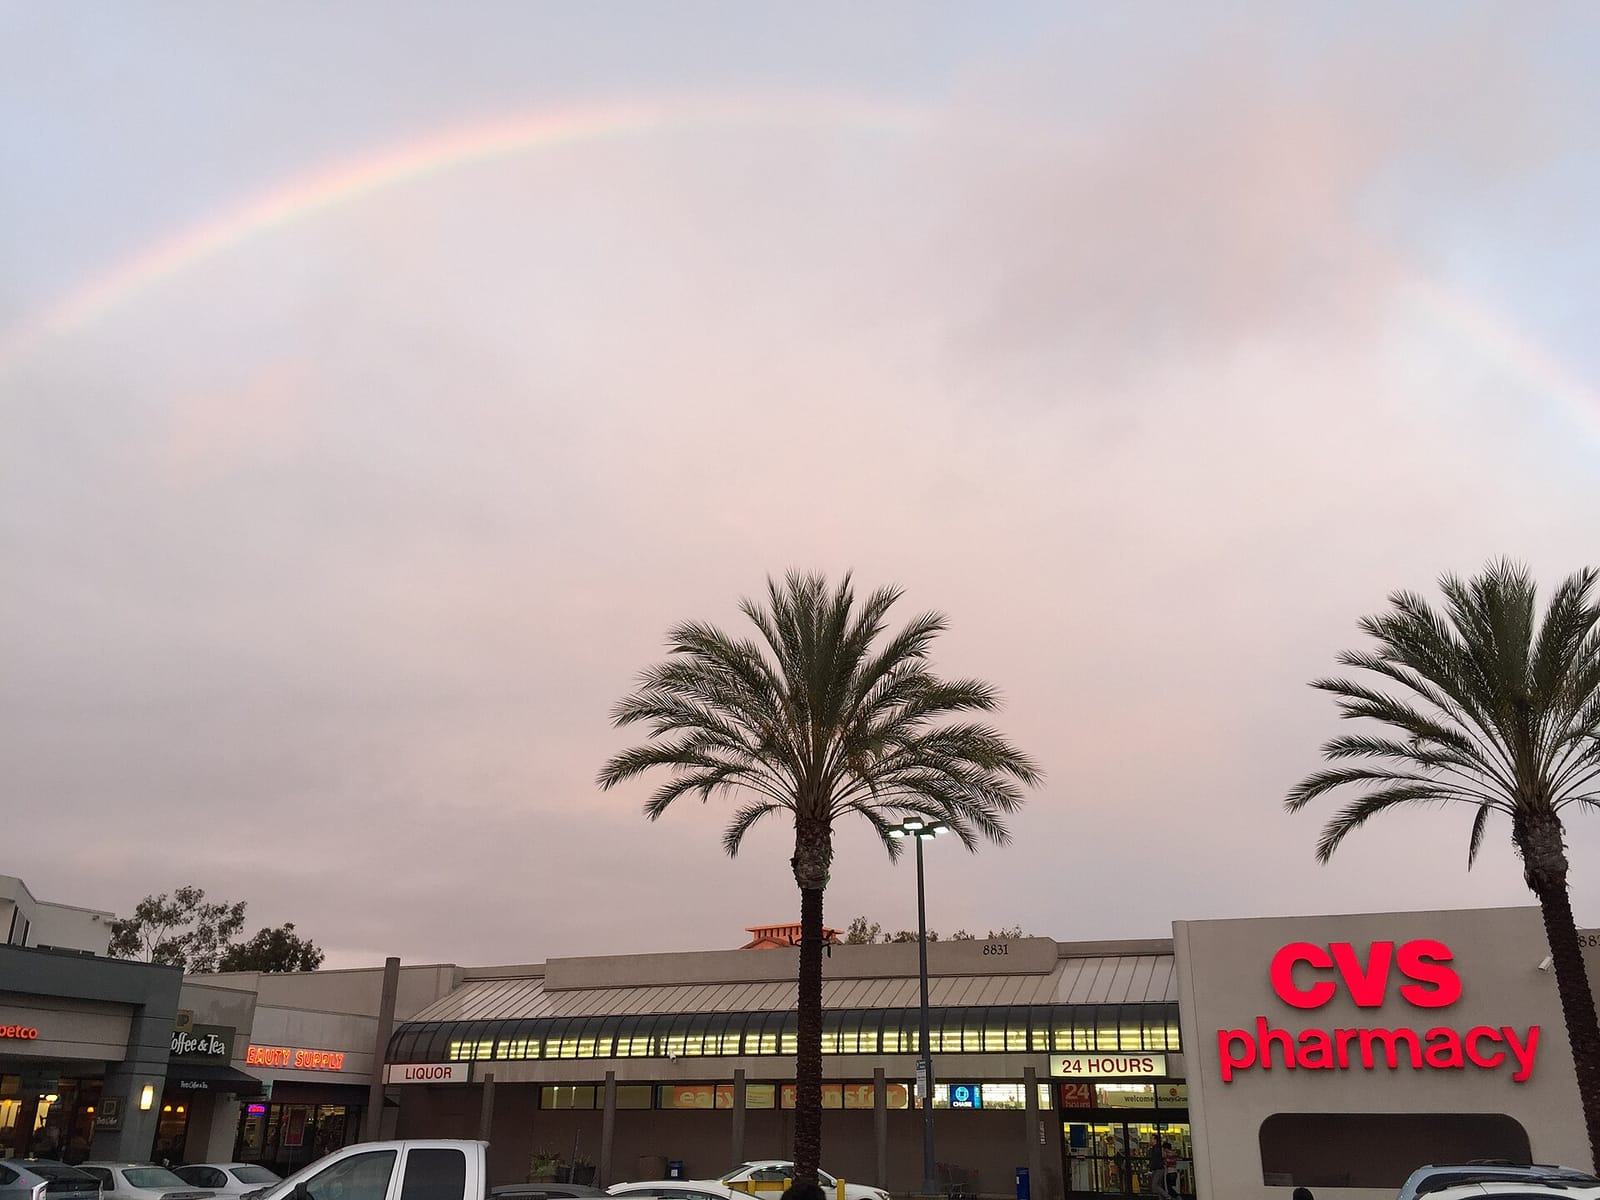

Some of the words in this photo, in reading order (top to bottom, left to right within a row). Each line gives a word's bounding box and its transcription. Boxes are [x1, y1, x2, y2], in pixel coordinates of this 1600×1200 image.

[982, 943, 1009, 956] 8831
[1578, 934, 1600, 948] 88
[1270, 939, 1462, 1009] CVS
[170, 1031, 197, 1055] offee
[197, 1040, 208, 1052] &
[207, 1034, 226, 1055] Tea
[1216, 1016, 1540, 1082] pharmacy
[294, 1050, 344, 1070] SUPPLY
[1062, 1060, 1082, 1073] 24
[1088, 1058, 1154, 1073] HOURS
[405, 1066, 452, 1080] LIQUOR
[783, 1086, 898, 1108] tnsfr
[1064, 1084, 1090, 1099] 24
